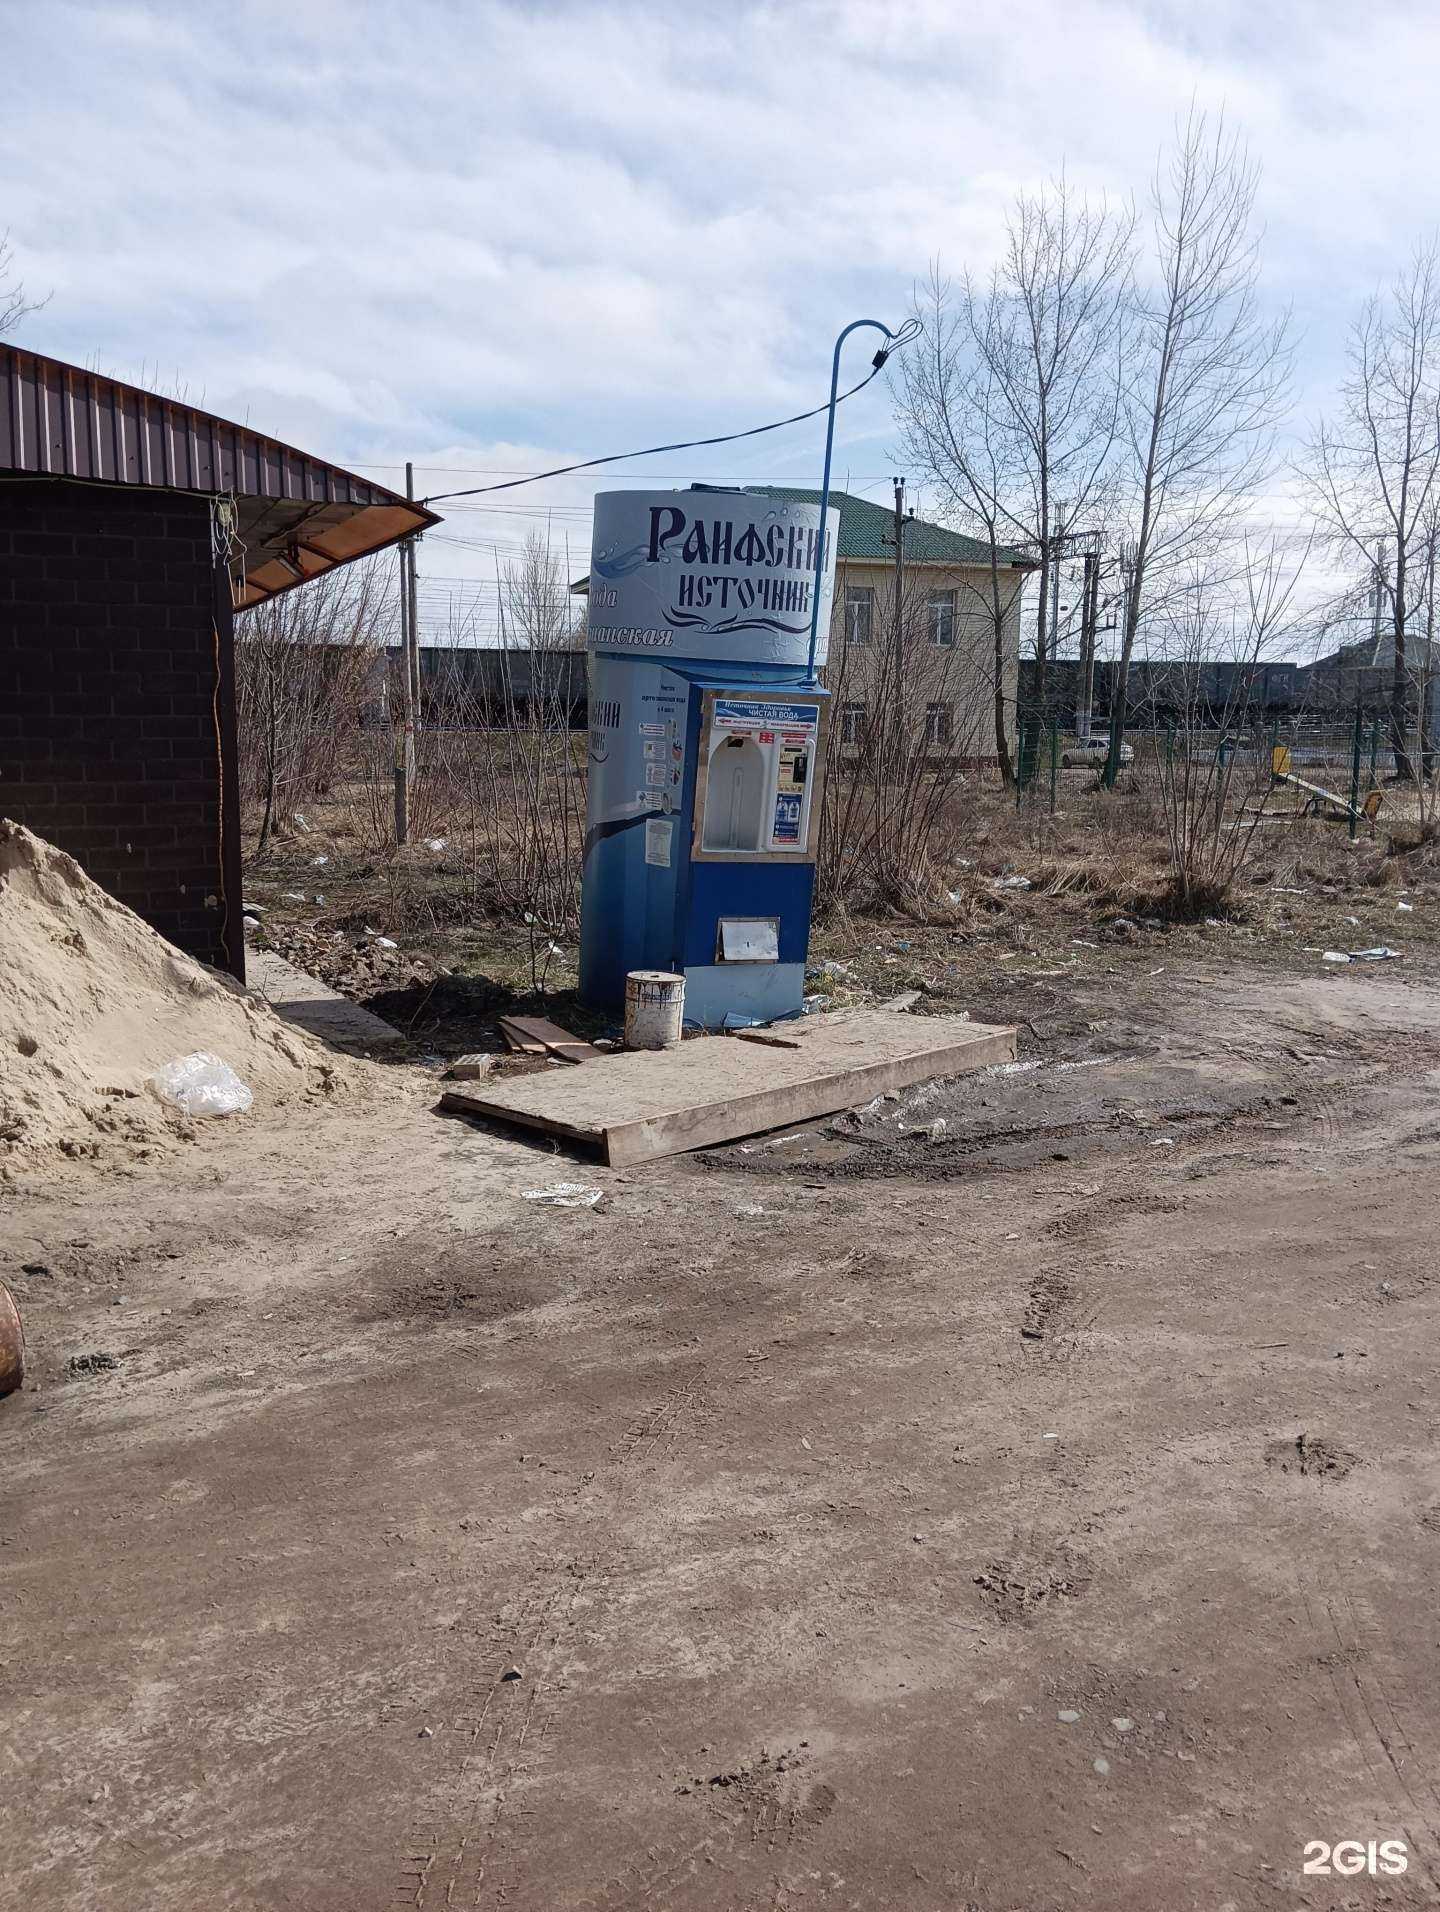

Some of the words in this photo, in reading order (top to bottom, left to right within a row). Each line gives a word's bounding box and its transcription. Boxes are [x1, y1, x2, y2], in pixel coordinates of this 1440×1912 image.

[593, 582, 618, 608] ода
[748, 709, 777, 718] ЧИСТАЯ
[778, 711, 799, 721] ВОДА
